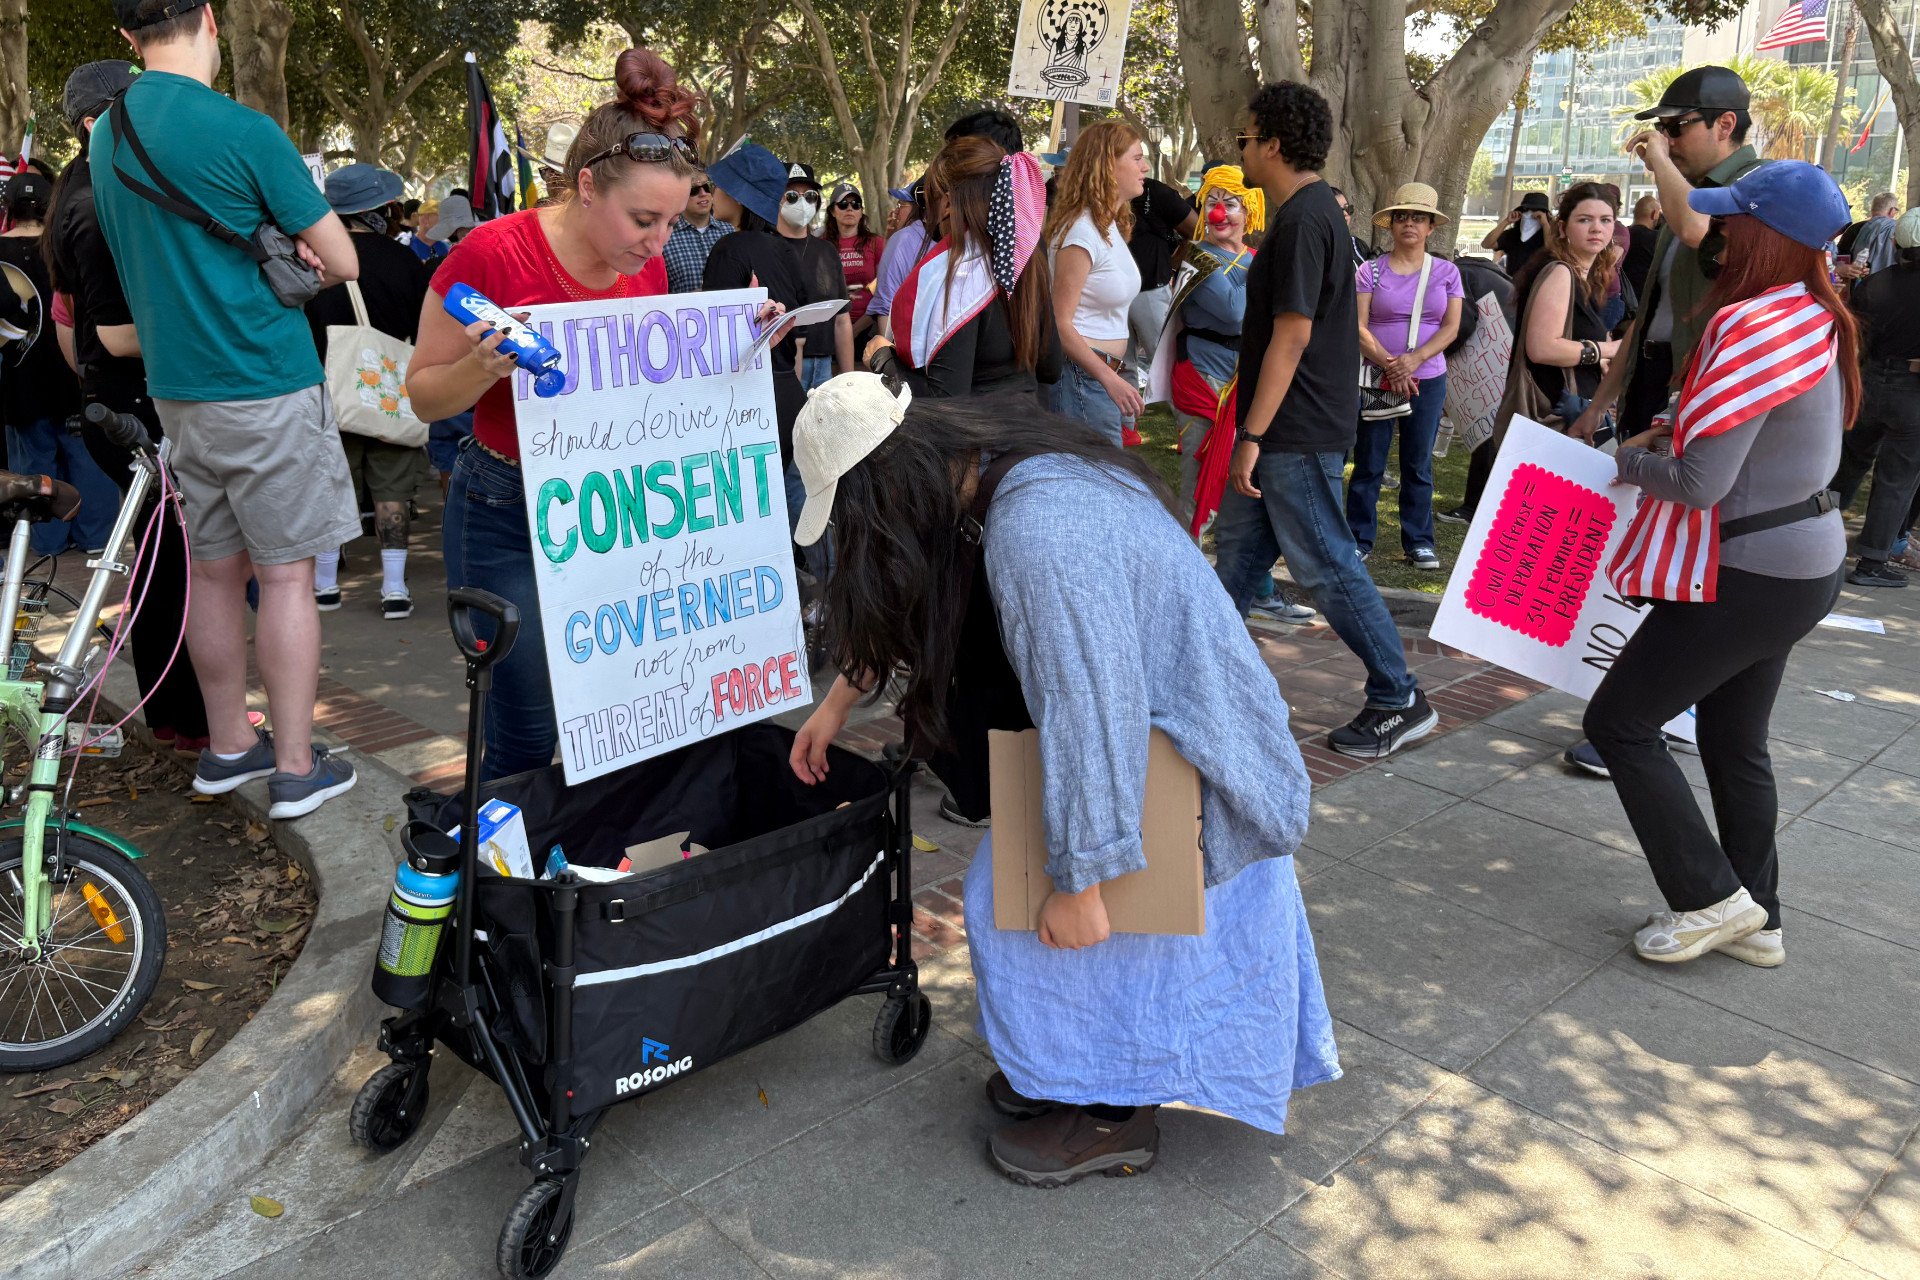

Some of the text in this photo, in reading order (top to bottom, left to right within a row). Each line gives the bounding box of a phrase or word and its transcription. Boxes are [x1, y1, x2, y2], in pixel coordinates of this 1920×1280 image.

[1477, 316, 1505, 349] BUT
[1451, 351, 1493, 399] FORGET
[531, 385, 770, 460] should derive from
[1456, 398, 1477, 427] ARE
[537, 441, 777, 563] CONSENT
[1493, 500, 1535, 563] Offense
[640, 540, 724, 601] of the
[1504, 505, 1559, 607] DEPORTATION
[1525, 598, 1551, 629] 34
[1538, 525, 1579, 595] Felonies
[1553, 512, 1608, 619] PRESIDENT
[565, 565, 784, 663] GOVERNED
[635, 634, 746, 690] not from
[1581, 623, 1628, 672] NO
[563, 651, 802, 772] THREAT of FORCE
[1374, 714, 1404, 737] HOKA
[105, 986, 136, 1027] KENDA
[616, 1056, 693, 1095] ROSONG
